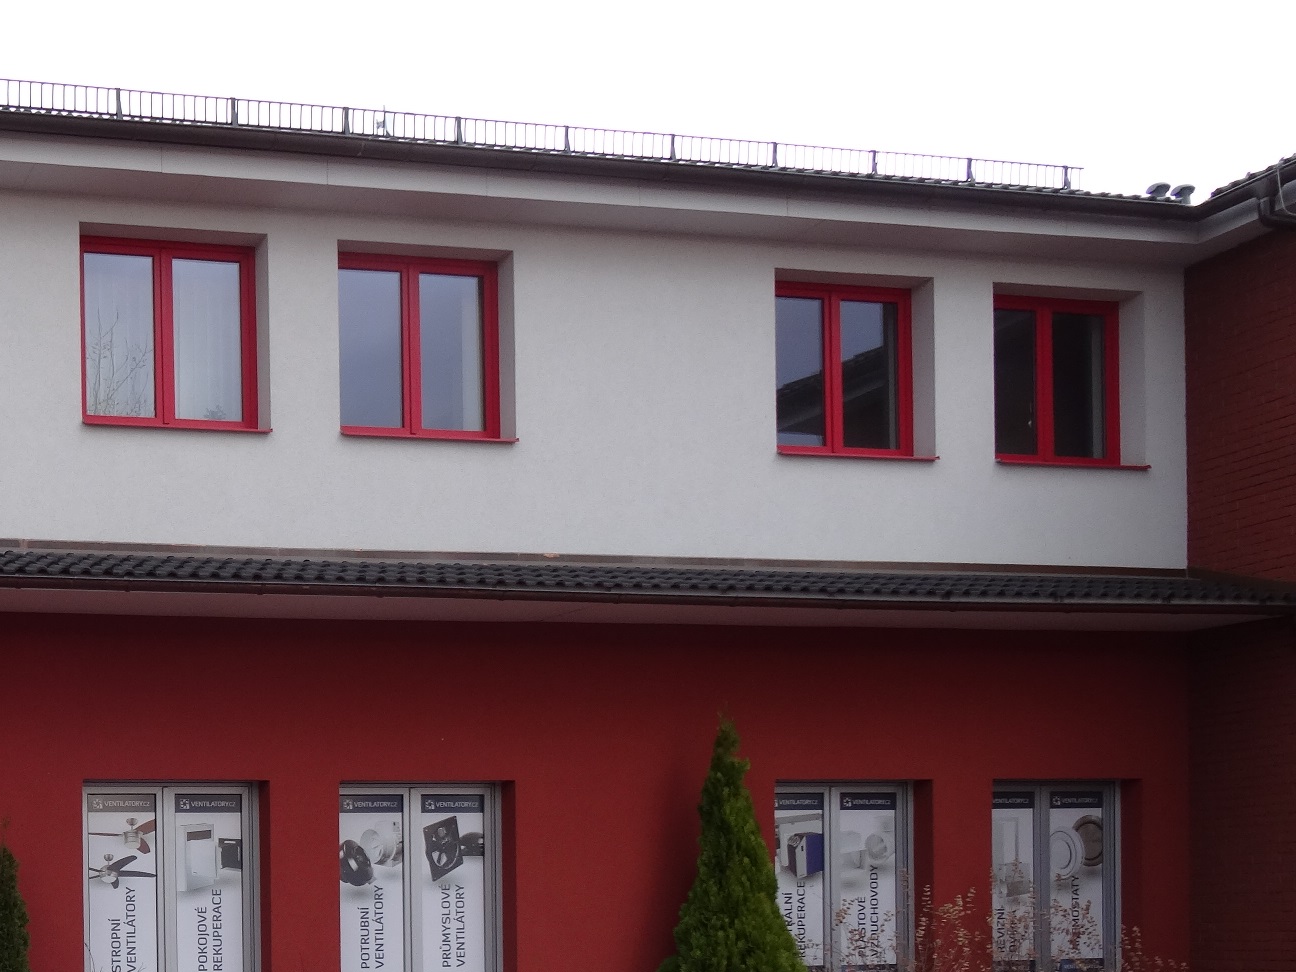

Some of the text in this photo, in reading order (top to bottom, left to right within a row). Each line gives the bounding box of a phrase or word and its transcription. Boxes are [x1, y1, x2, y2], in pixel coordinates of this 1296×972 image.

[108, 918, 122, 972] STROPNÍ
[123, 886, 136, 972] VENTILÁTORY
[194, 906, 209, 972] POKOJOVÉ
[212, 888, 223, 972] REKUPERACE
[357, 906, 370, 969] POTRUBNÍ
[372, 885, 385, 969] VENTILÁTORY
[438, 883, 452, 968] PRŮMYSLOVÉ
[453, 884, 466, 968] VENTILÁTORY
